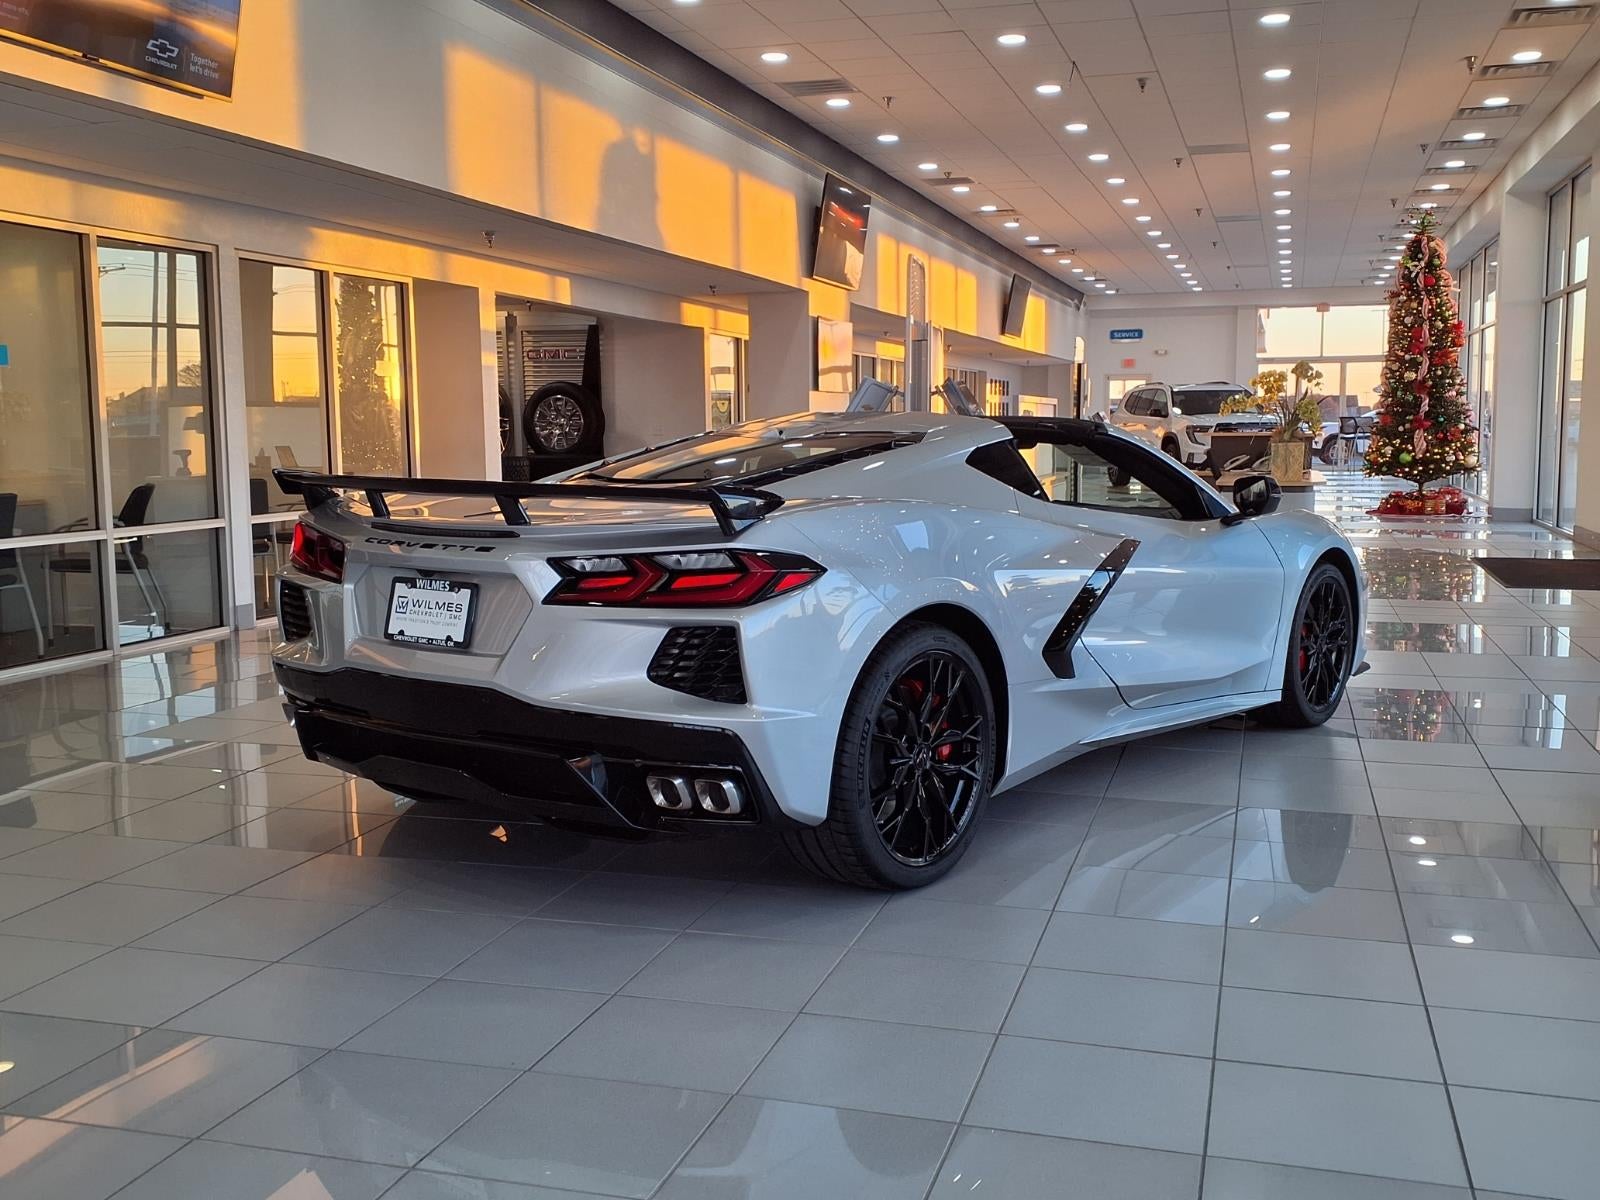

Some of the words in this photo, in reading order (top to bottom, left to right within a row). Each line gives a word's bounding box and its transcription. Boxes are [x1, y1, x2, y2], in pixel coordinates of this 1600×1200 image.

[191, 53, 218, 69] Together
[203, 68, 219, 79] drive
[527, 348, 579, 361] GMC
[365, 537, 496, 552] CORVETTE
[416, 578, 450, 592] WILMES
[411, 598, 463, 613] WILMES
[409, 609, 443, 619] CHEVROLET
[448, 613, 463, 621] GMC
[393, 634, 418, 643] CHEVROLET
[857, 720, 870, 790] MICHELIN
